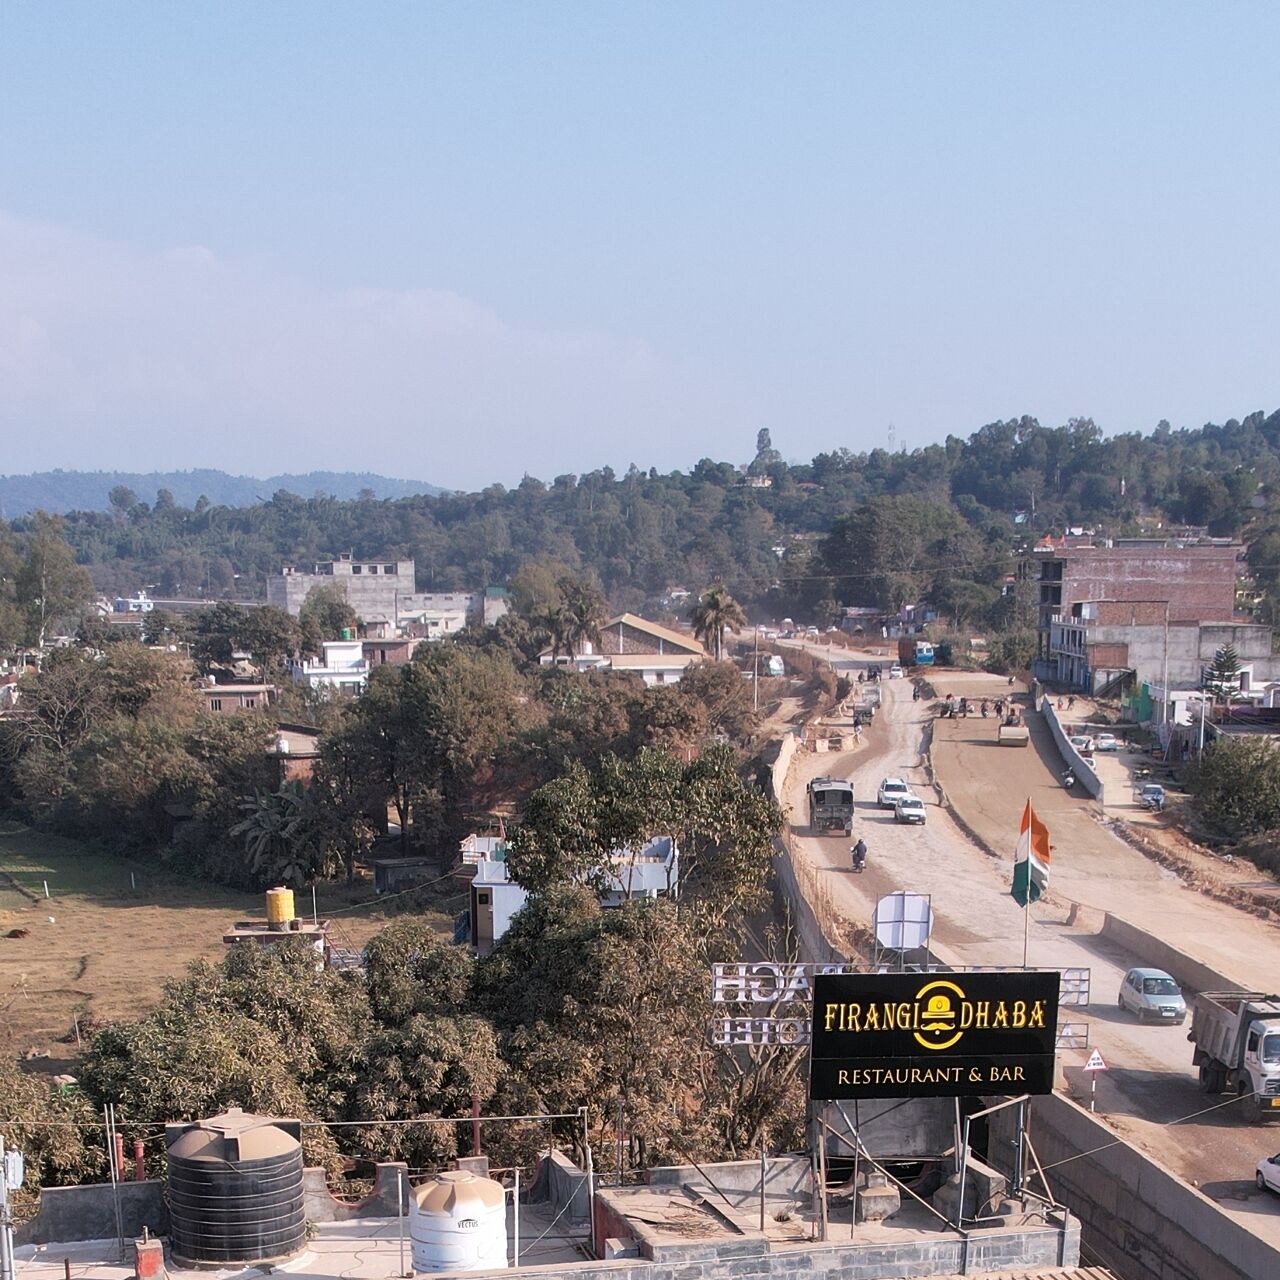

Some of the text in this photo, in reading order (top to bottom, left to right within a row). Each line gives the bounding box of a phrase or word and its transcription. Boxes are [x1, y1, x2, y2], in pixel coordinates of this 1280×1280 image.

[825, 1001, 1046, 1031] FIRANGI DHABA
[838, 1066, 1026, 1085] RESTAURANT & BAR
[457, 1220, 479, 1228] VECTUS
